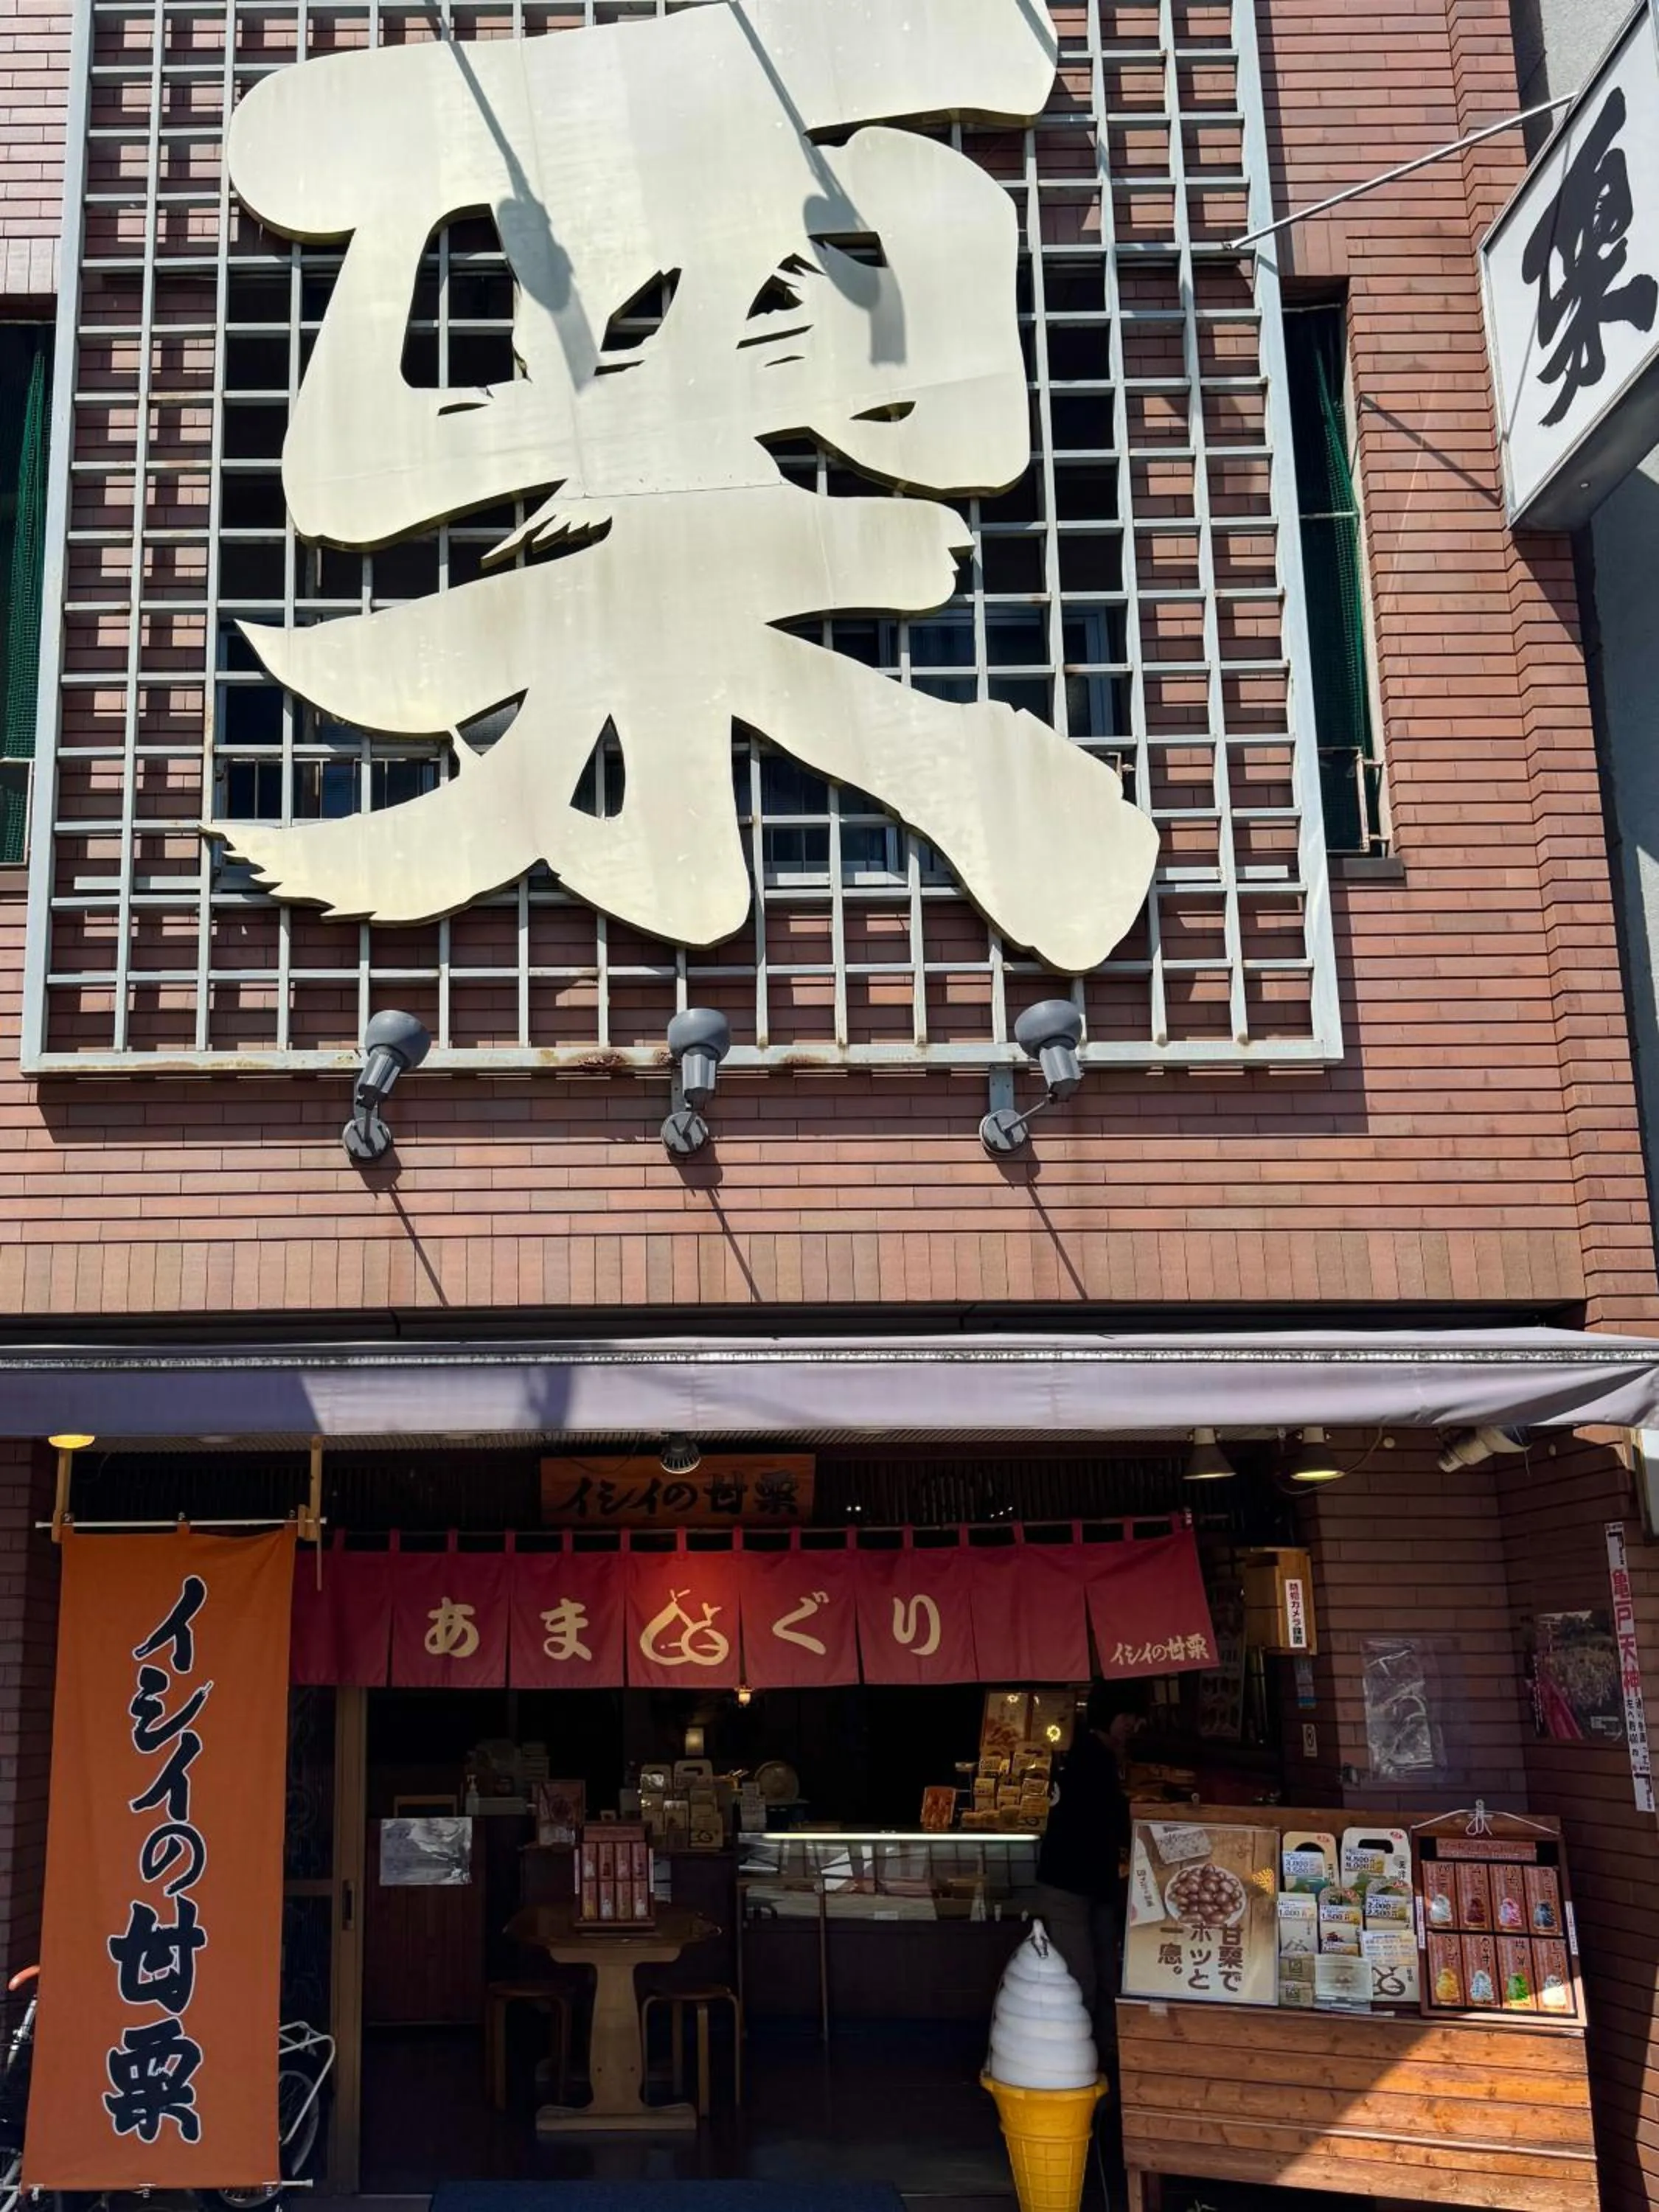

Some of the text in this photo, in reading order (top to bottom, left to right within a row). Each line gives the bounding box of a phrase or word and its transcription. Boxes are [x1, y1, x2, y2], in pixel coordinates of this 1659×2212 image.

[1521, 86, 1658, 427] 栗
[198, 0, 1160, 972] 栗
[558, 1470, 800, 1517] イシイの甘栗
[1110, 1632, 1210, 1666] イシイの甘栗
[1611, 1569, 1641, 1697] 亀戸天神
[102, 1574, 213, 2144] イシイの甘栗
[1158, 1927, 1184, 1975] 一息。
[1217, 1923, 1245, 1992] 甘栗で
